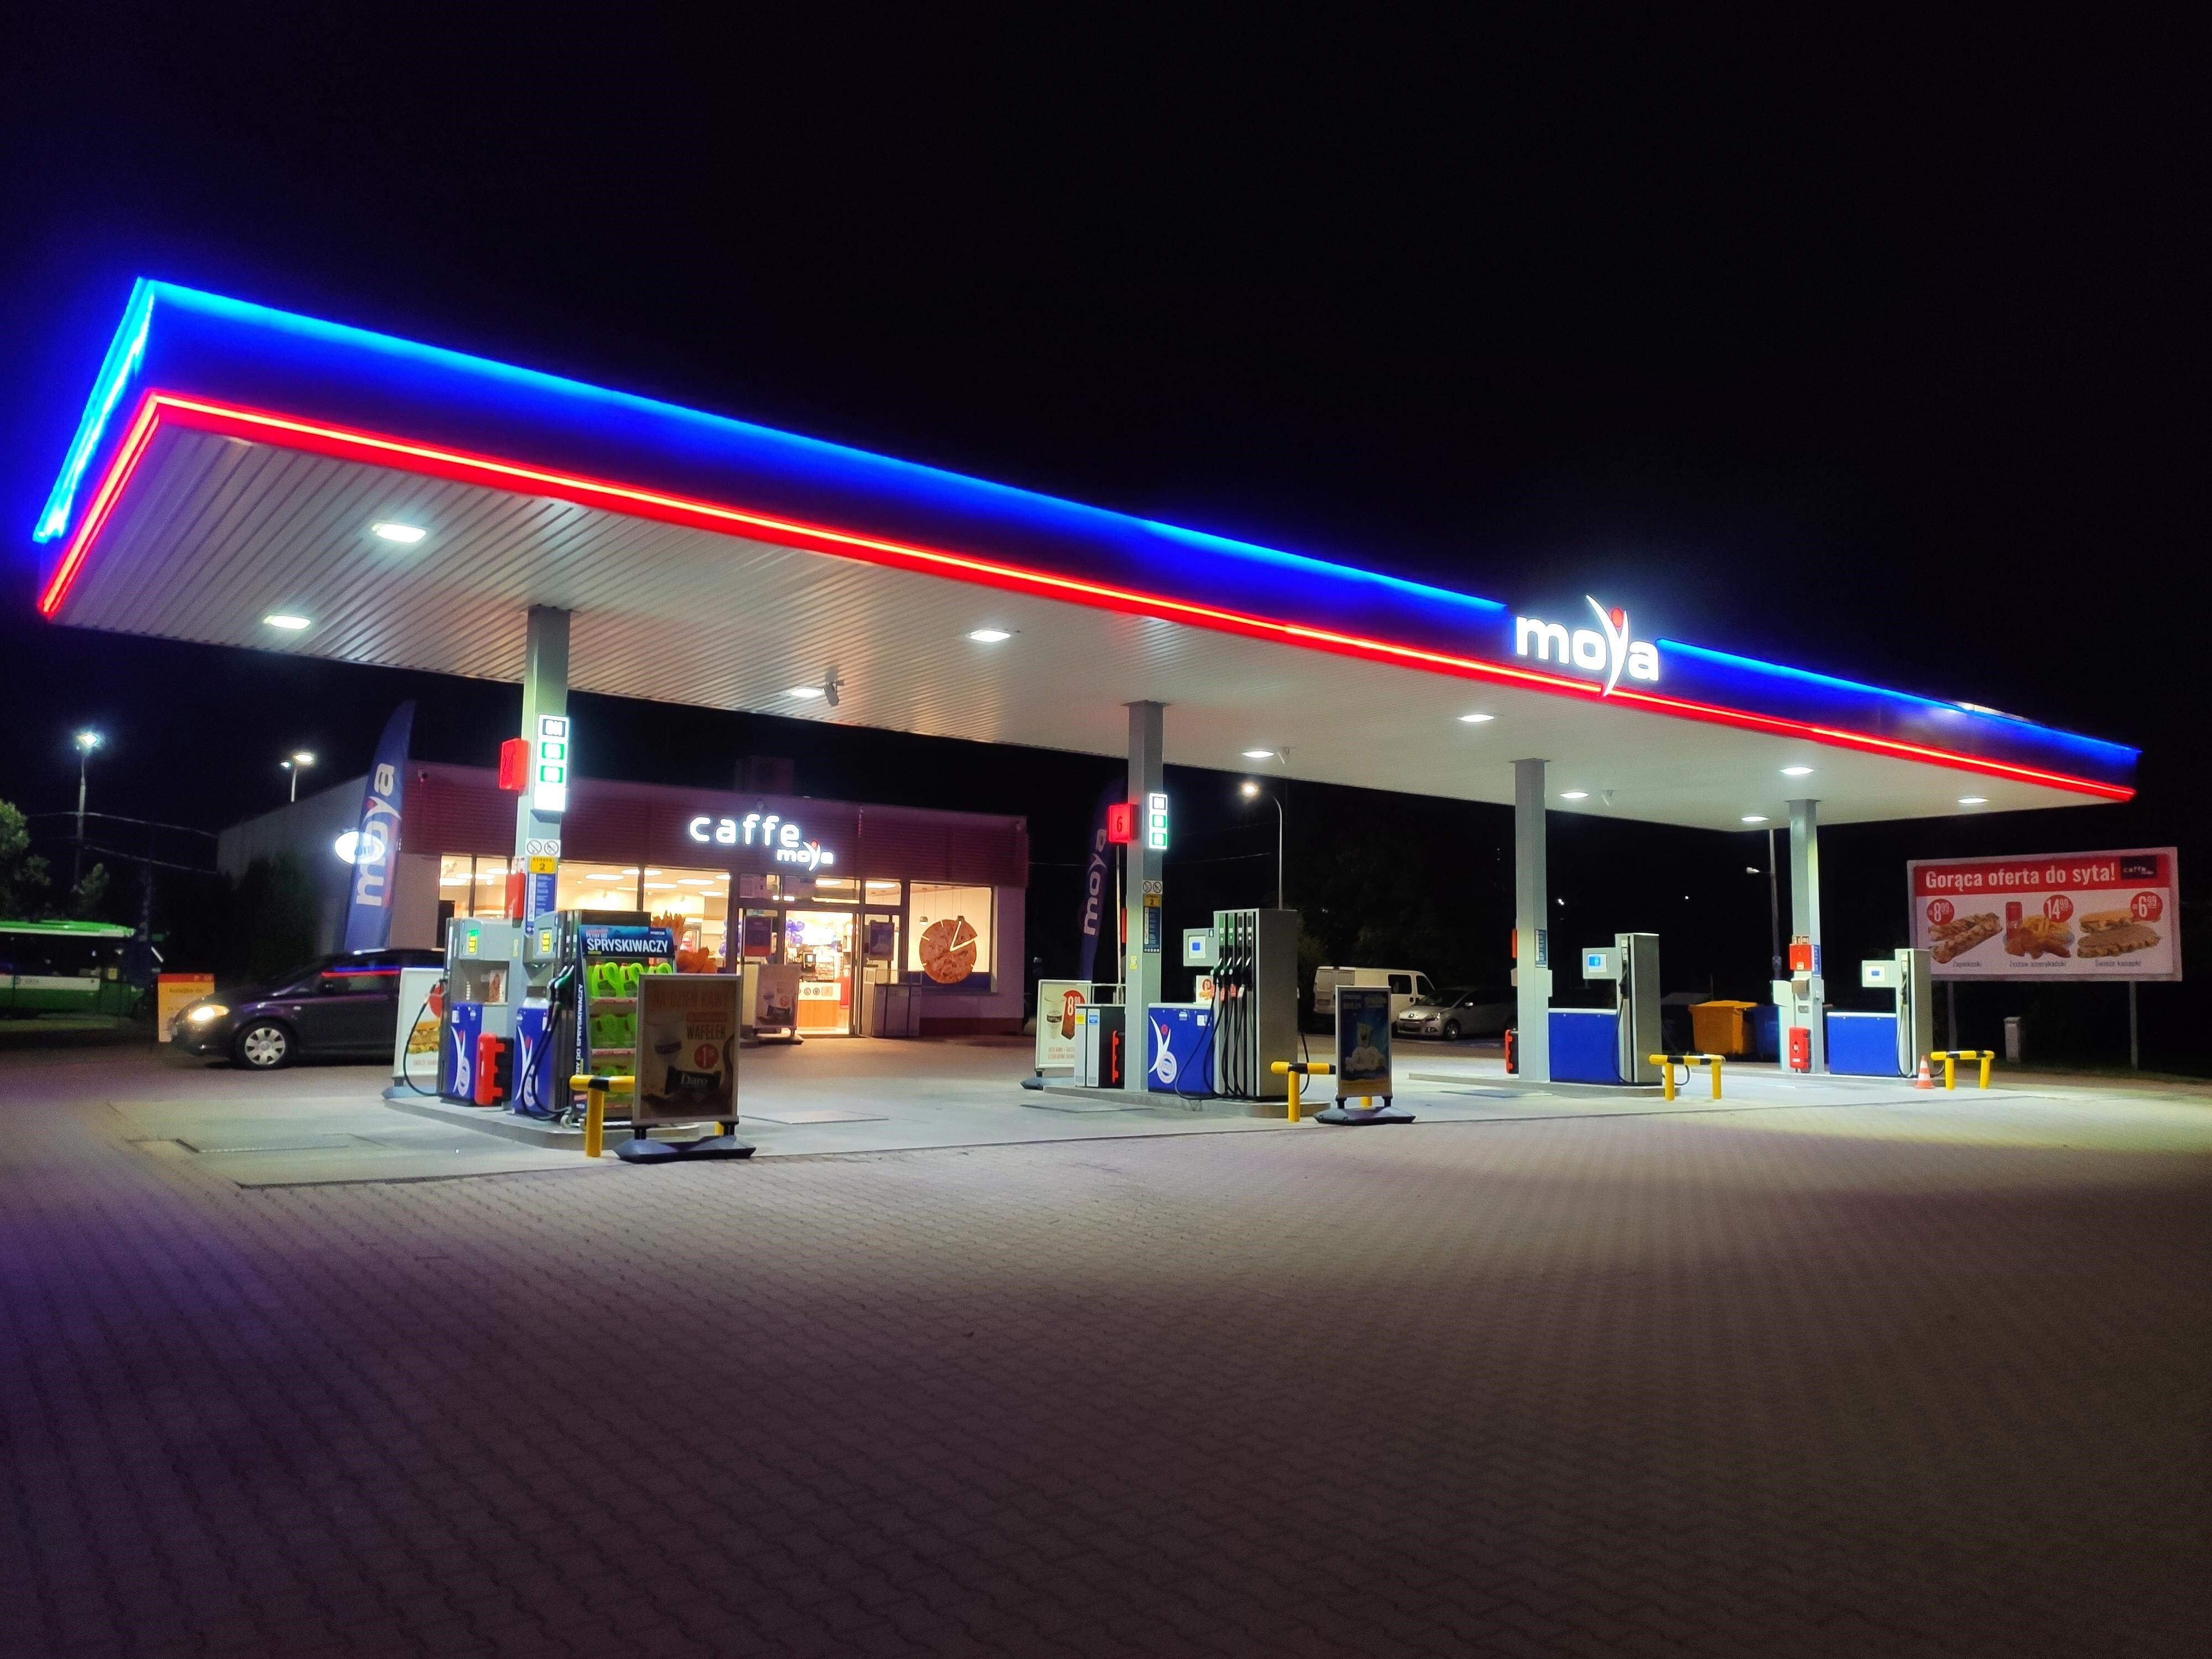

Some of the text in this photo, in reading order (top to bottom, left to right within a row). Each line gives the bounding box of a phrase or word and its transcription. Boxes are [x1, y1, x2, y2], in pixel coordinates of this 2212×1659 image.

[1516, 594, 1660, 696] moya
[356, 763, 401, 906] moya
[690, 813, 800, 848] caffe
[1117, 816, 1123, 833] 6
[539, 863, 545, 871] 2
[776, 841, 834, 872] moya
[1084, 828, 1107, 935] moya
[1926, 862, 2115, 891] Gorąca oferta do syta!
[586, 938, 668, 953] SPRYSKIWACZY
[687, 1024, 726, 1040] WAFELEK
